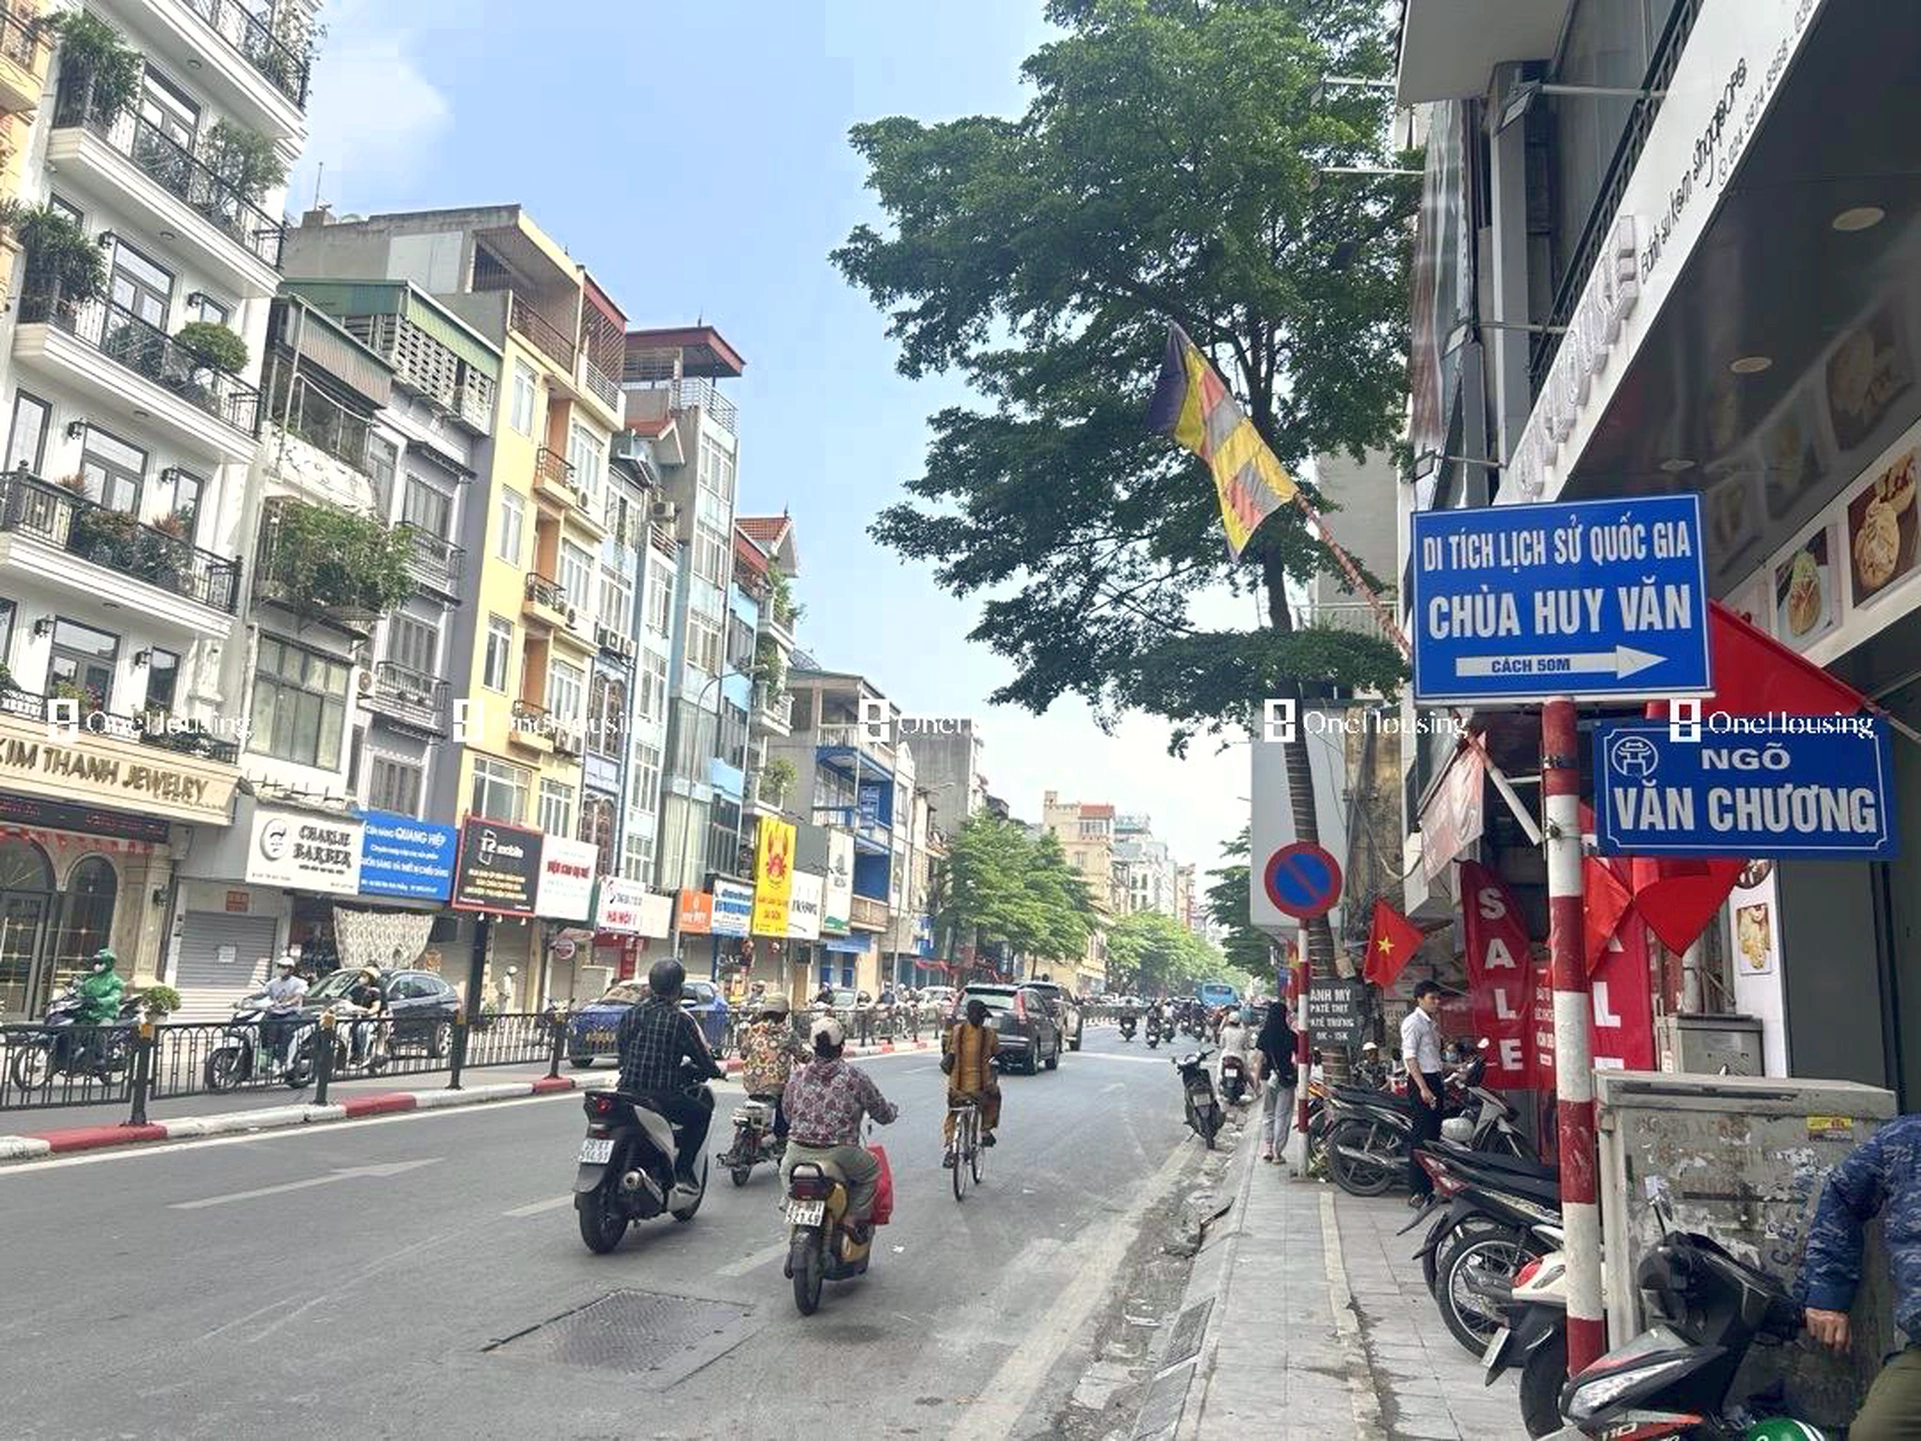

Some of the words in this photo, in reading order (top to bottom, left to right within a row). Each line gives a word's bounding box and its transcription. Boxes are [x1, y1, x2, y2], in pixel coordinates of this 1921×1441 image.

[1424, 536, 1443, 572] DI
[1449, 527, 1495, 571] TÍCH
[1500, 530, 1546, 573] LỊCH
[1554, 514, 1583, 566] SỬ
[1590, 511, 1646, 566] QUỐC
[1653, 520, 1692, 559] GIA
[1429, 584, 1521, 640] CHÙA
[1534, 588, 1605, 636] HUY
[1618, 575, 1693, 632] VĂN
[1491, 656, 1533, 674] CÁCH
[1537, 657, 1571, 673] 50M
[1701, 742, 1791, 770] NGÕ
[43, 746, 120, 786] THANH
[121, 764, 210, 801] JEWELRY
[1614, 778, 1695, 831] VĂN
[1707, 783, 1877, 834] CHƯƠNG
[299, 825, 351, 847] CHARLIE
[292, 842, 352, 869] BARBER
[1479, 887, 1523, 1071] SALE
[1310, 988, 1332, 1002] ANH
[1310, 1016, 1325, 1028] ATÊ
